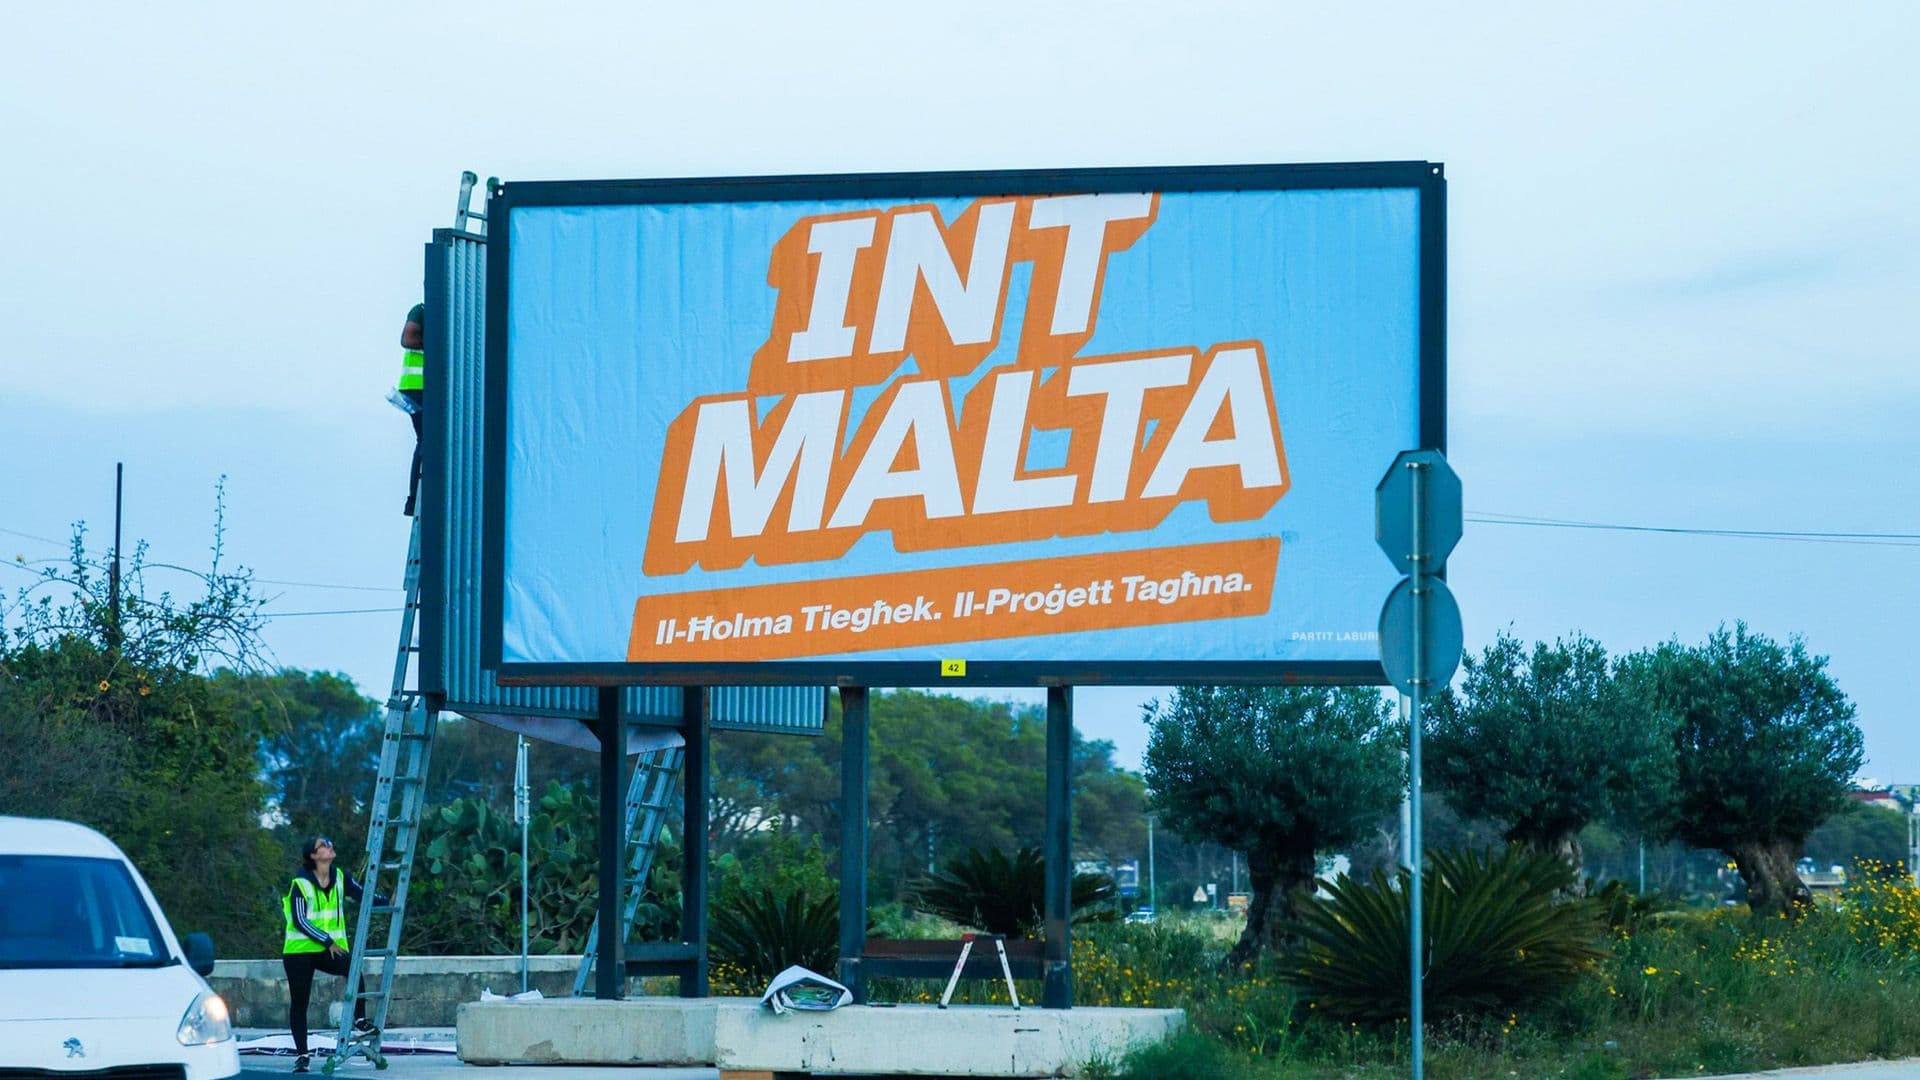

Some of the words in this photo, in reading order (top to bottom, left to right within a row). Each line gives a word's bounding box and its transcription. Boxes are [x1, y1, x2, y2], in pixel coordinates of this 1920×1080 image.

[787, 193, 1153, 363] INT
[675, 348, 1282, 543] MALTA
[655, 612, 793, 645] Il-Ħolma
[800, 596, 942, 634] Tiegħek.
[953, 581, 1114, 618] Il-Proġett
[1121, 570, 1253, 605] Tagħna.
[1291, 631, 1334, 641] PARTIT
[947, 663, 960, 673] 42
